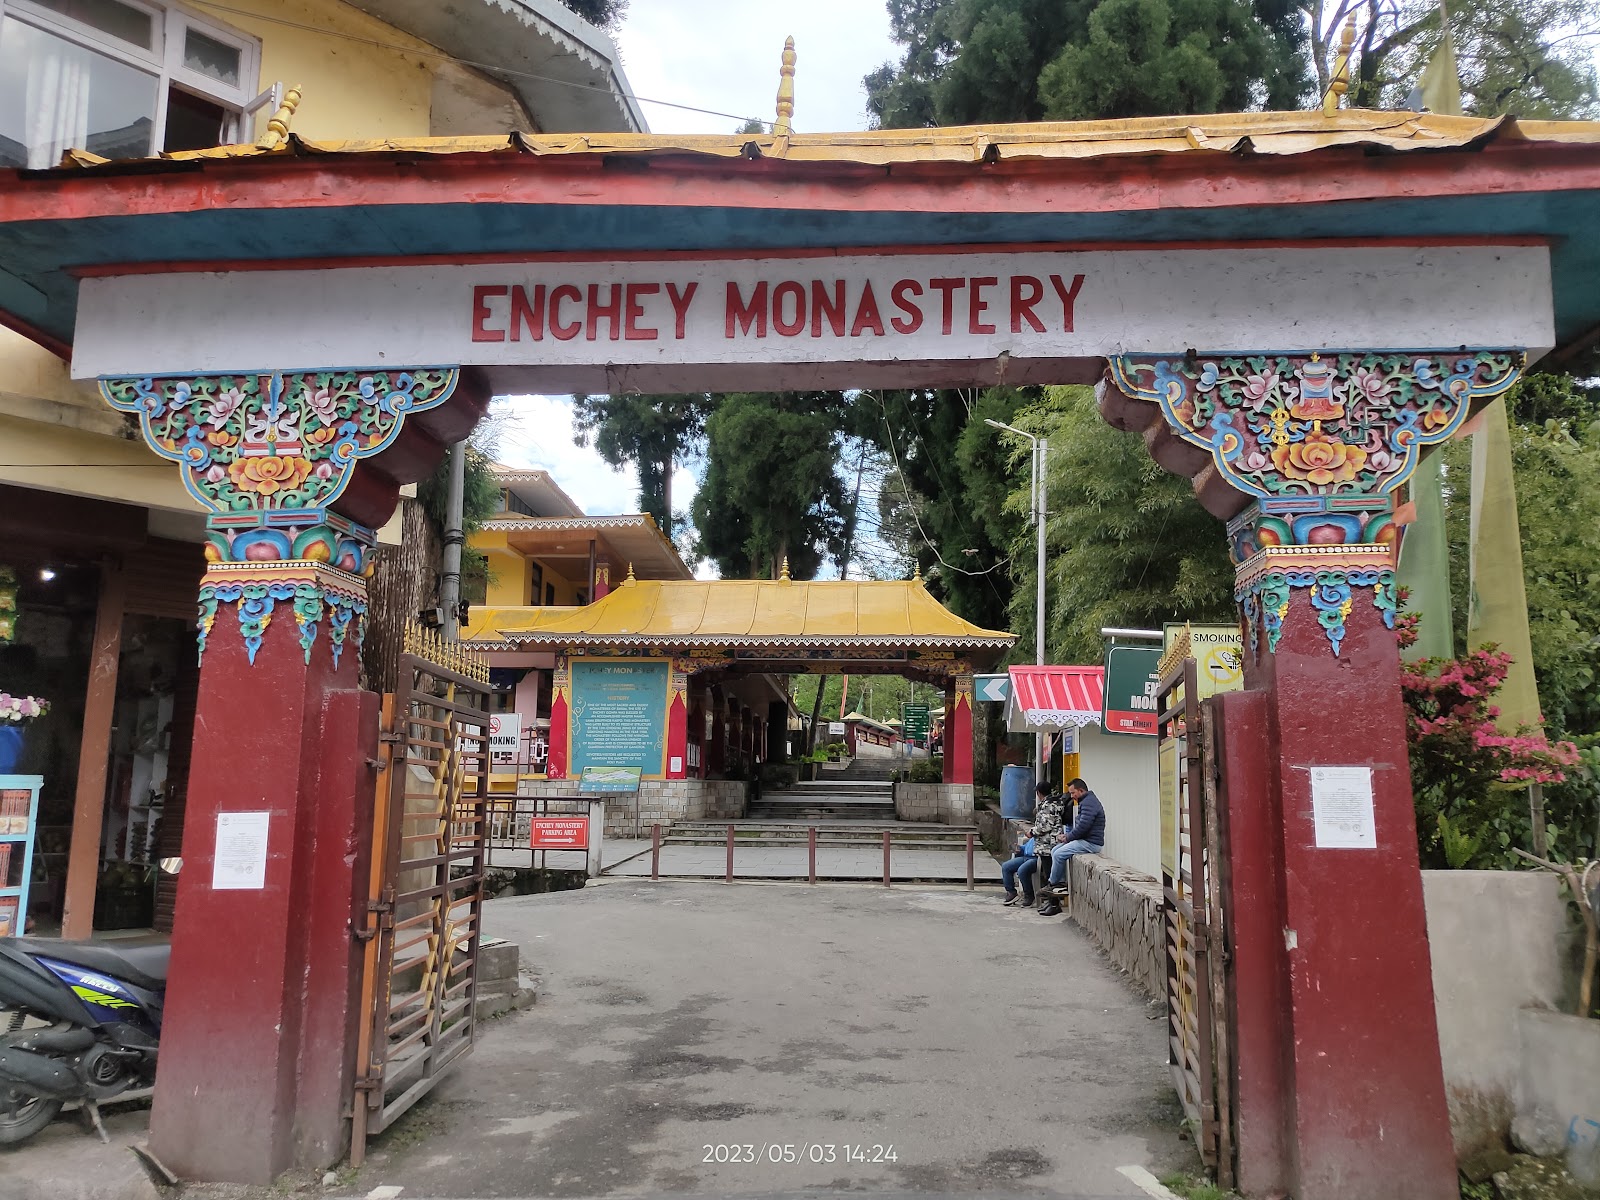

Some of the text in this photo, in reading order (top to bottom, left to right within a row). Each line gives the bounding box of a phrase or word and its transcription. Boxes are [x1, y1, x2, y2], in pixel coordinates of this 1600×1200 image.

[471, 274, 1085, 342] ENCHEY MONASTERY
[490, 736, 516, 745] OKING
